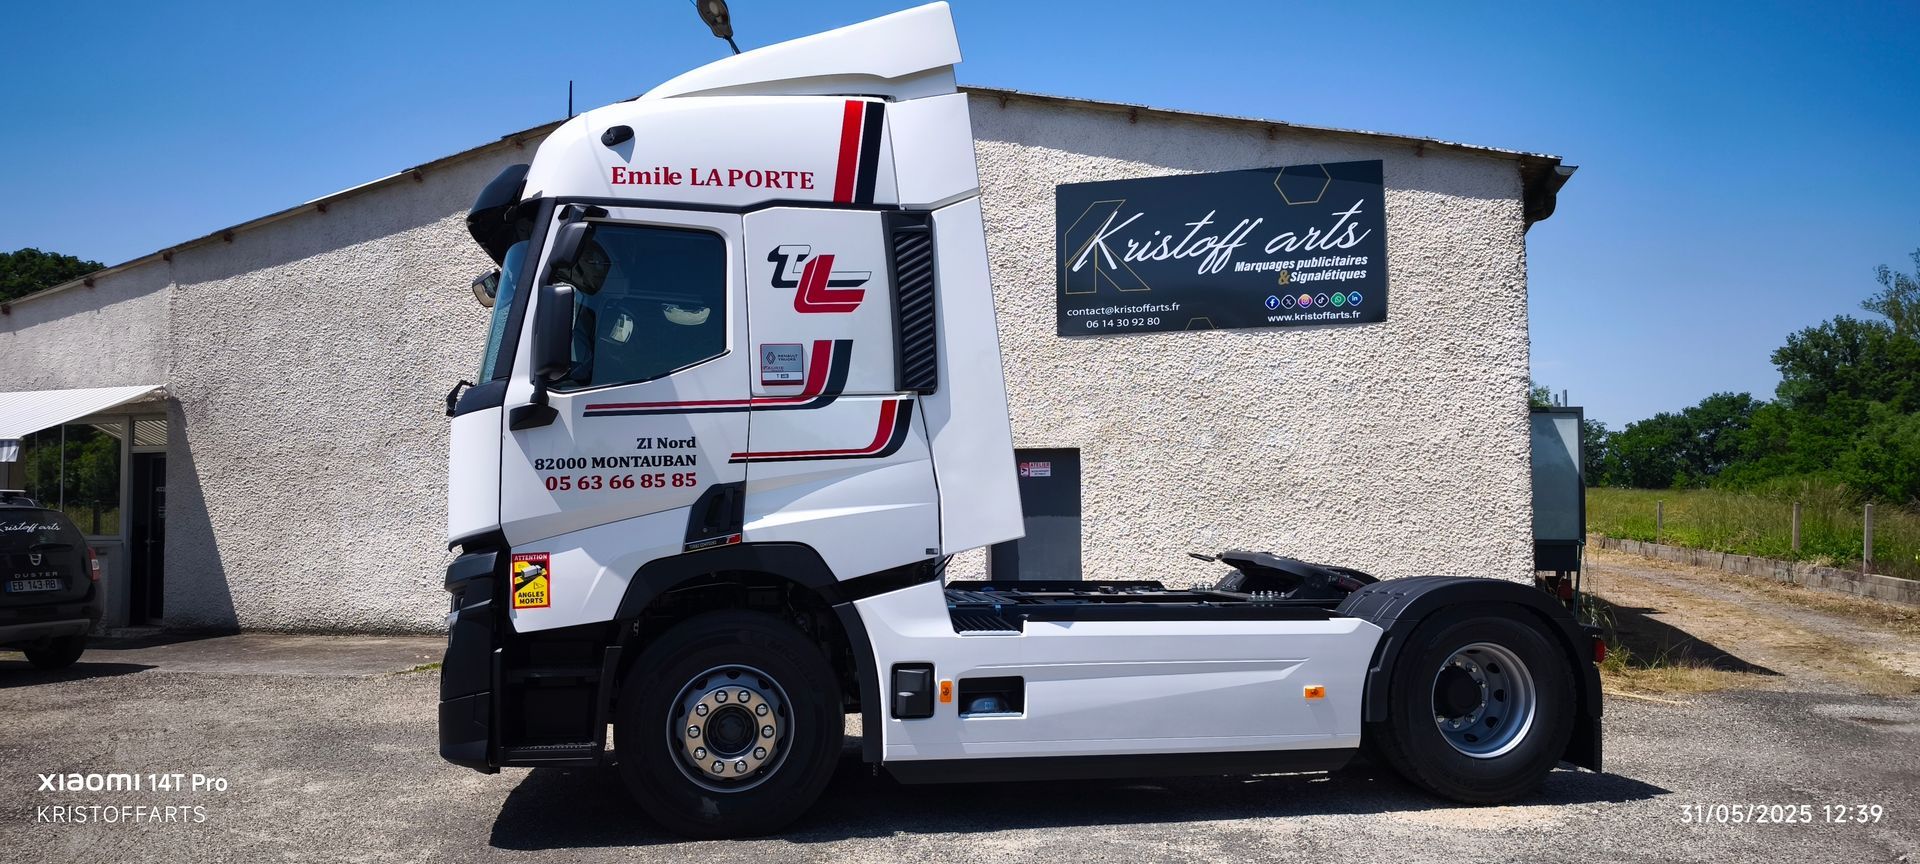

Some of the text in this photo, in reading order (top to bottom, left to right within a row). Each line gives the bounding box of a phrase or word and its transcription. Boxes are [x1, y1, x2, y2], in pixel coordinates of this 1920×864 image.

[611, 166, 682, 185] Emile
[1072, 198, 1372, 275] Kristoff arts
[1234, 255, 1368, 273] Marquages publicitaires
[1066, 302, 1181, 317] contact@kristoffarts.fr
[1267, 310, 1361, 322] www.kristoffarts.fr
[1086, 316, 1160, 329] 06 14 30 92 80
[636, 436, 697, 450] ZI Nord
[534, 455, 697, 471] 82000 MONTAUBAN
[545, 472, 697, 491] 05 63 66 85 85
[14, 571, 58, 579] DUSTER
[517, 591, 545, 599] ANGLES
